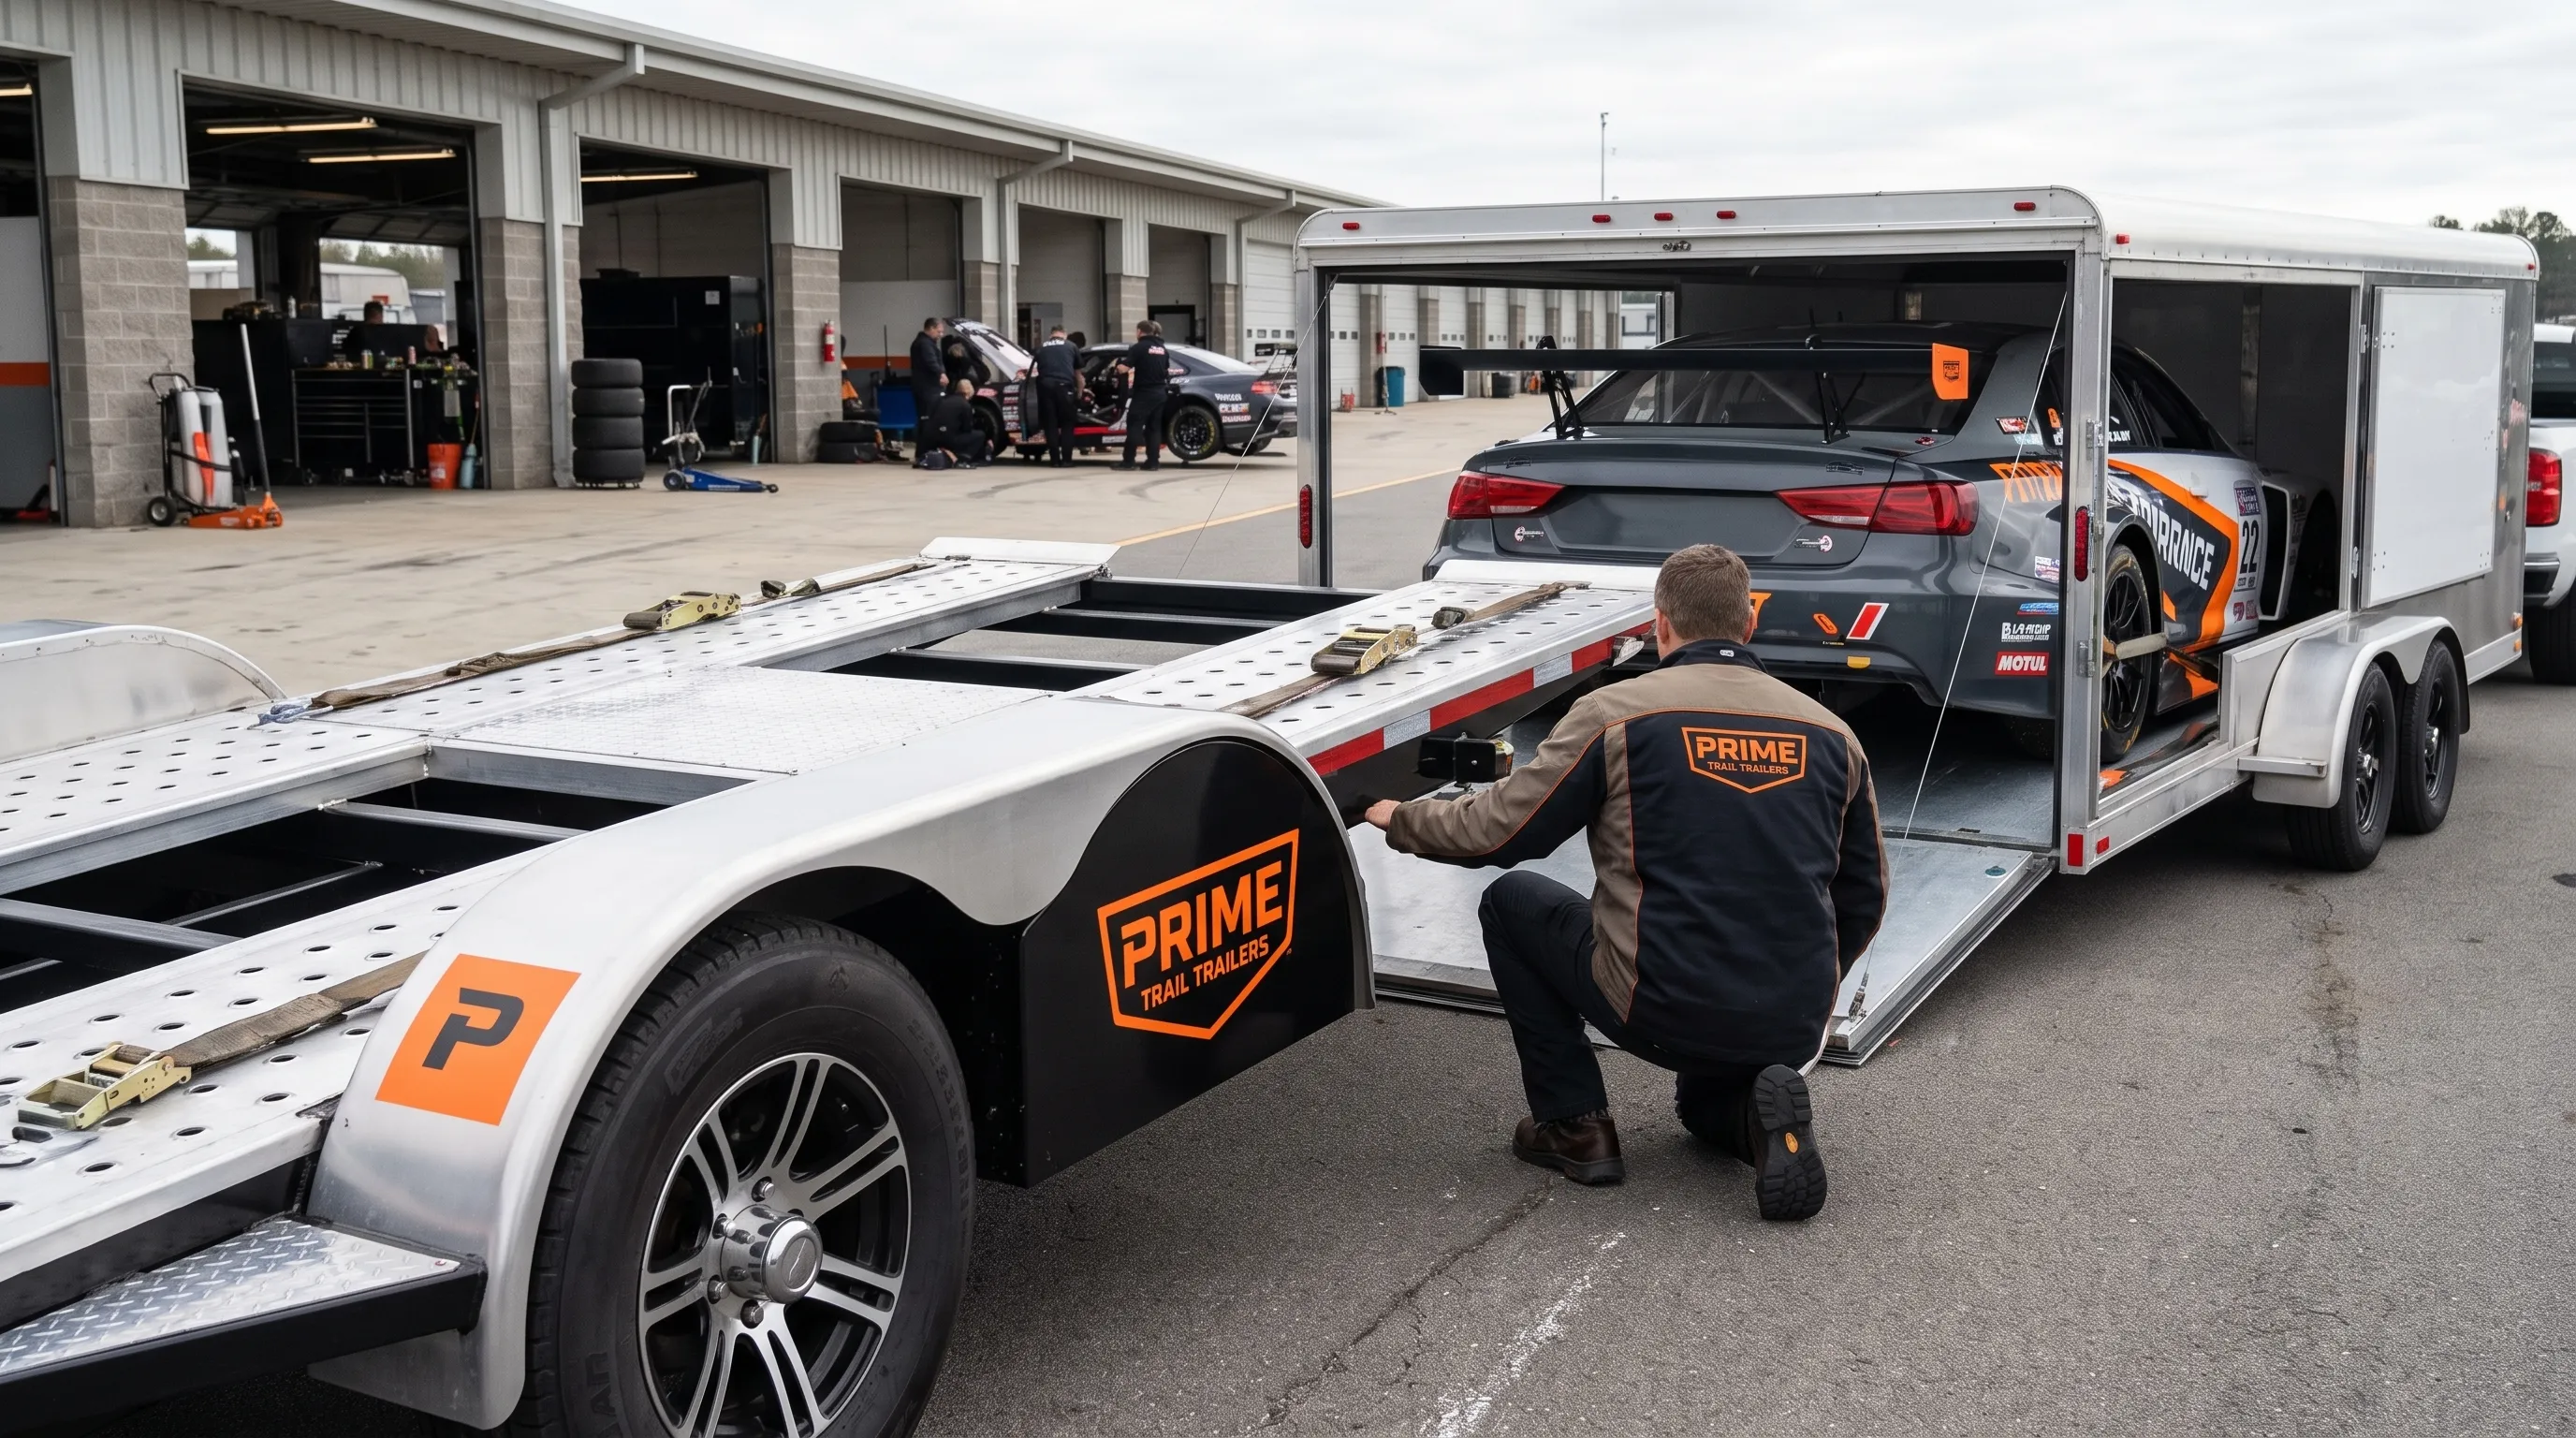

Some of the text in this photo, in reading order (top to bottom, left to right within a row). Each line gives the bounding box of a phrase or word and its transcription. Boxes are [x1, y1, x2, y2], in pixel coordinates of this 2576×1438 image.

[2239, 520, 2259, 574] 22
[1997, 654, 2046, 671] MOTUL
[1695, 736, 1798, 764] PRIME
[1707, 761, 1789, 775] TRAIL TRAILERS
[1120, 859, 1282, 990] PRIME
[1140, 933, 1269, 1011] TRAIL TRAILERS
